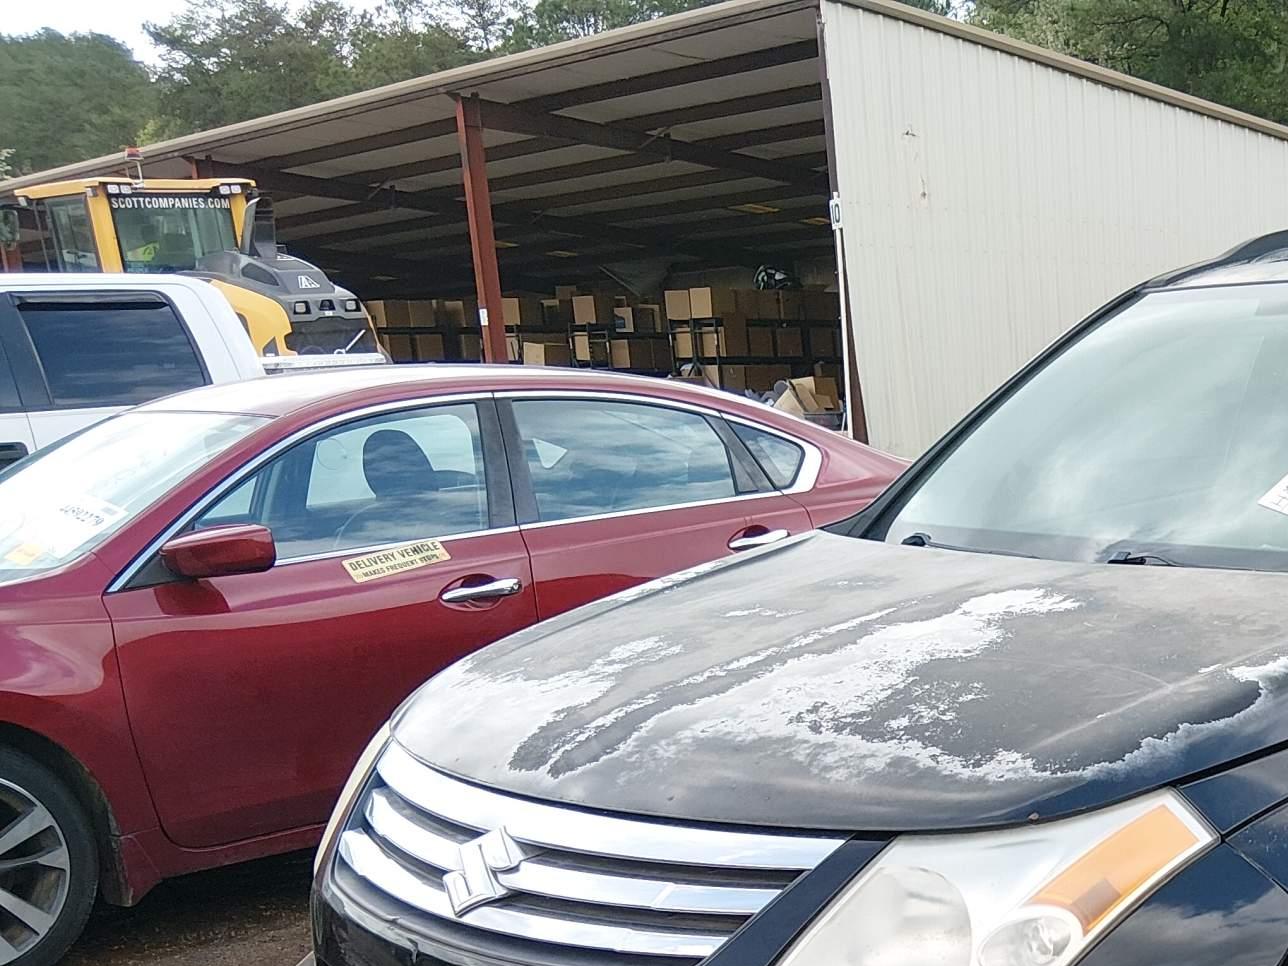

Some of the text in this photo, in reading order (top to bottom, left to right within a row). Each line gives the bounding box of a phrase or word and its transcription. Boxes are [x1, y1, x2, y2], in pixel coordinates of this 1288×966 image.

[112, 197, 230, 209] SCOTTCOMPANIES.COM
[349, 541, 440, 571] DELIVERY VEHICLE
[362, 567, 386, 578] MAKES
[386, 558, 420, 573] FREQUENT
